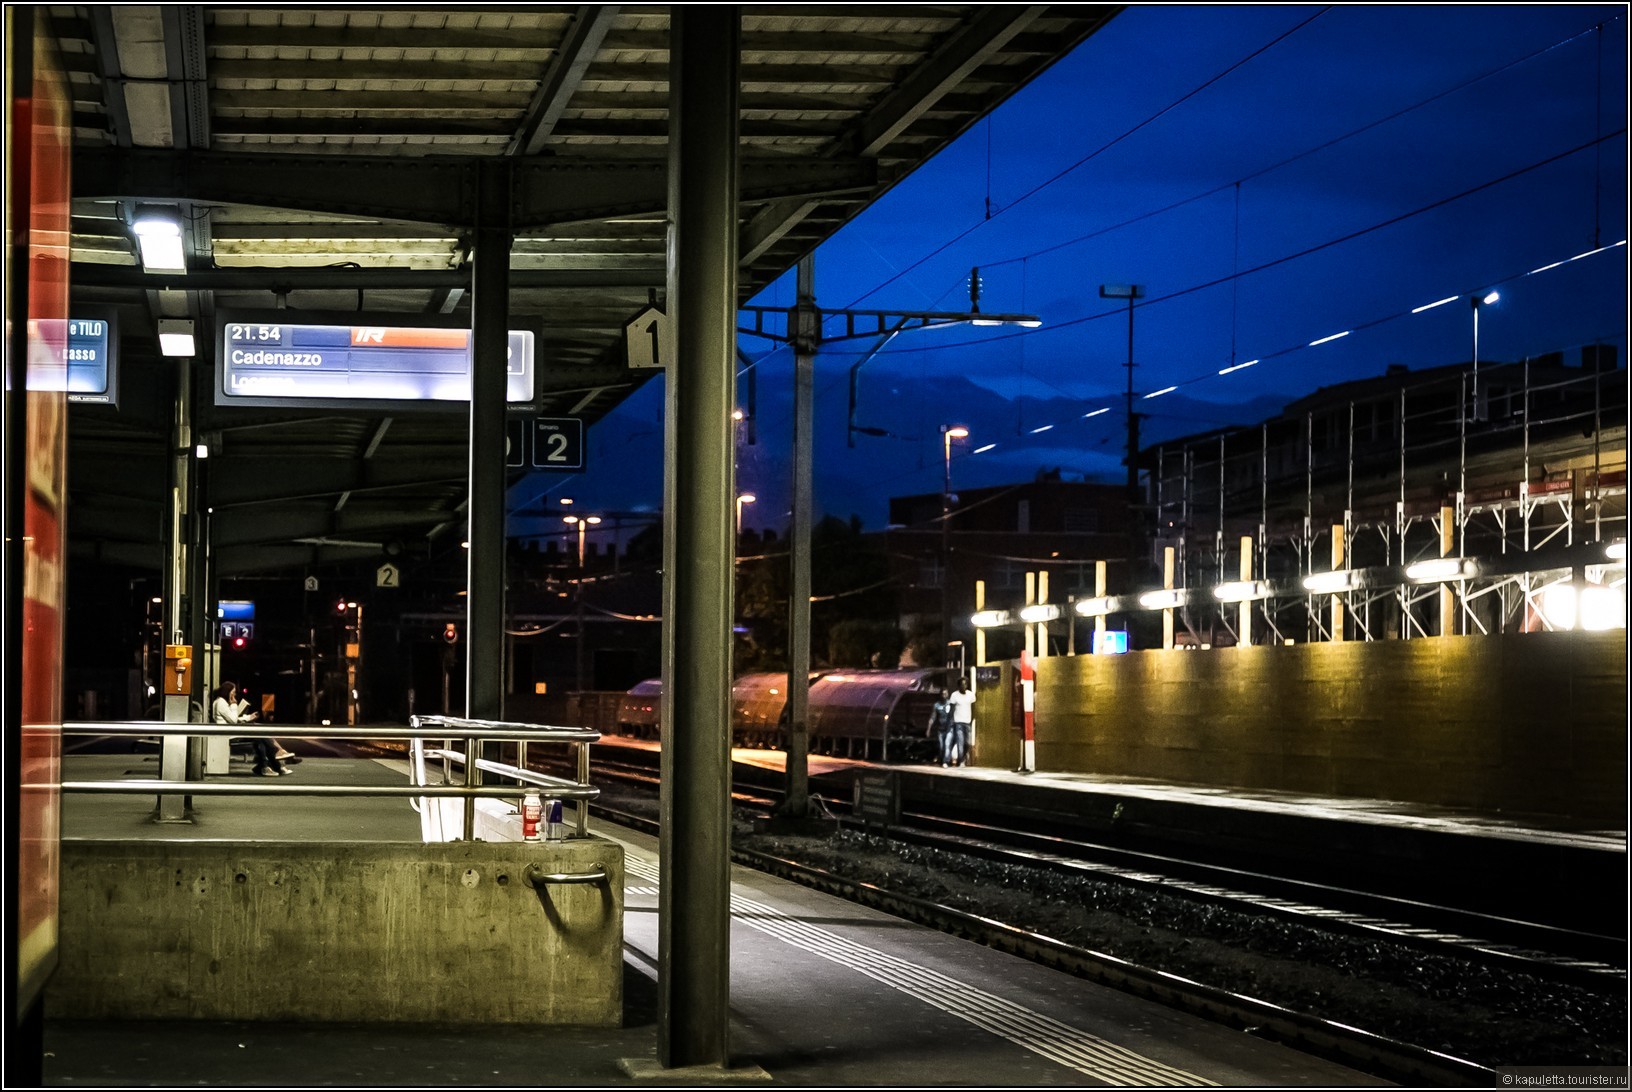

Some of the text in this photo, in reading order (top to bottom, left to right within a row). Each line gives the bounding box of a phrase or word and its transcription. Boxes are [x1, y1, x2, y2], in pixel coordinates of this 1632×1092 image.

[78, 322, 102, 336] TILO
[231, 326, 386, 343] 21.54 IR
[645, 319, 660, 364] 1
[231, 350, 322, 366] Cadenazzo
[547, 433, 568, 462] 2
[382, 567, 393, 585] 2
